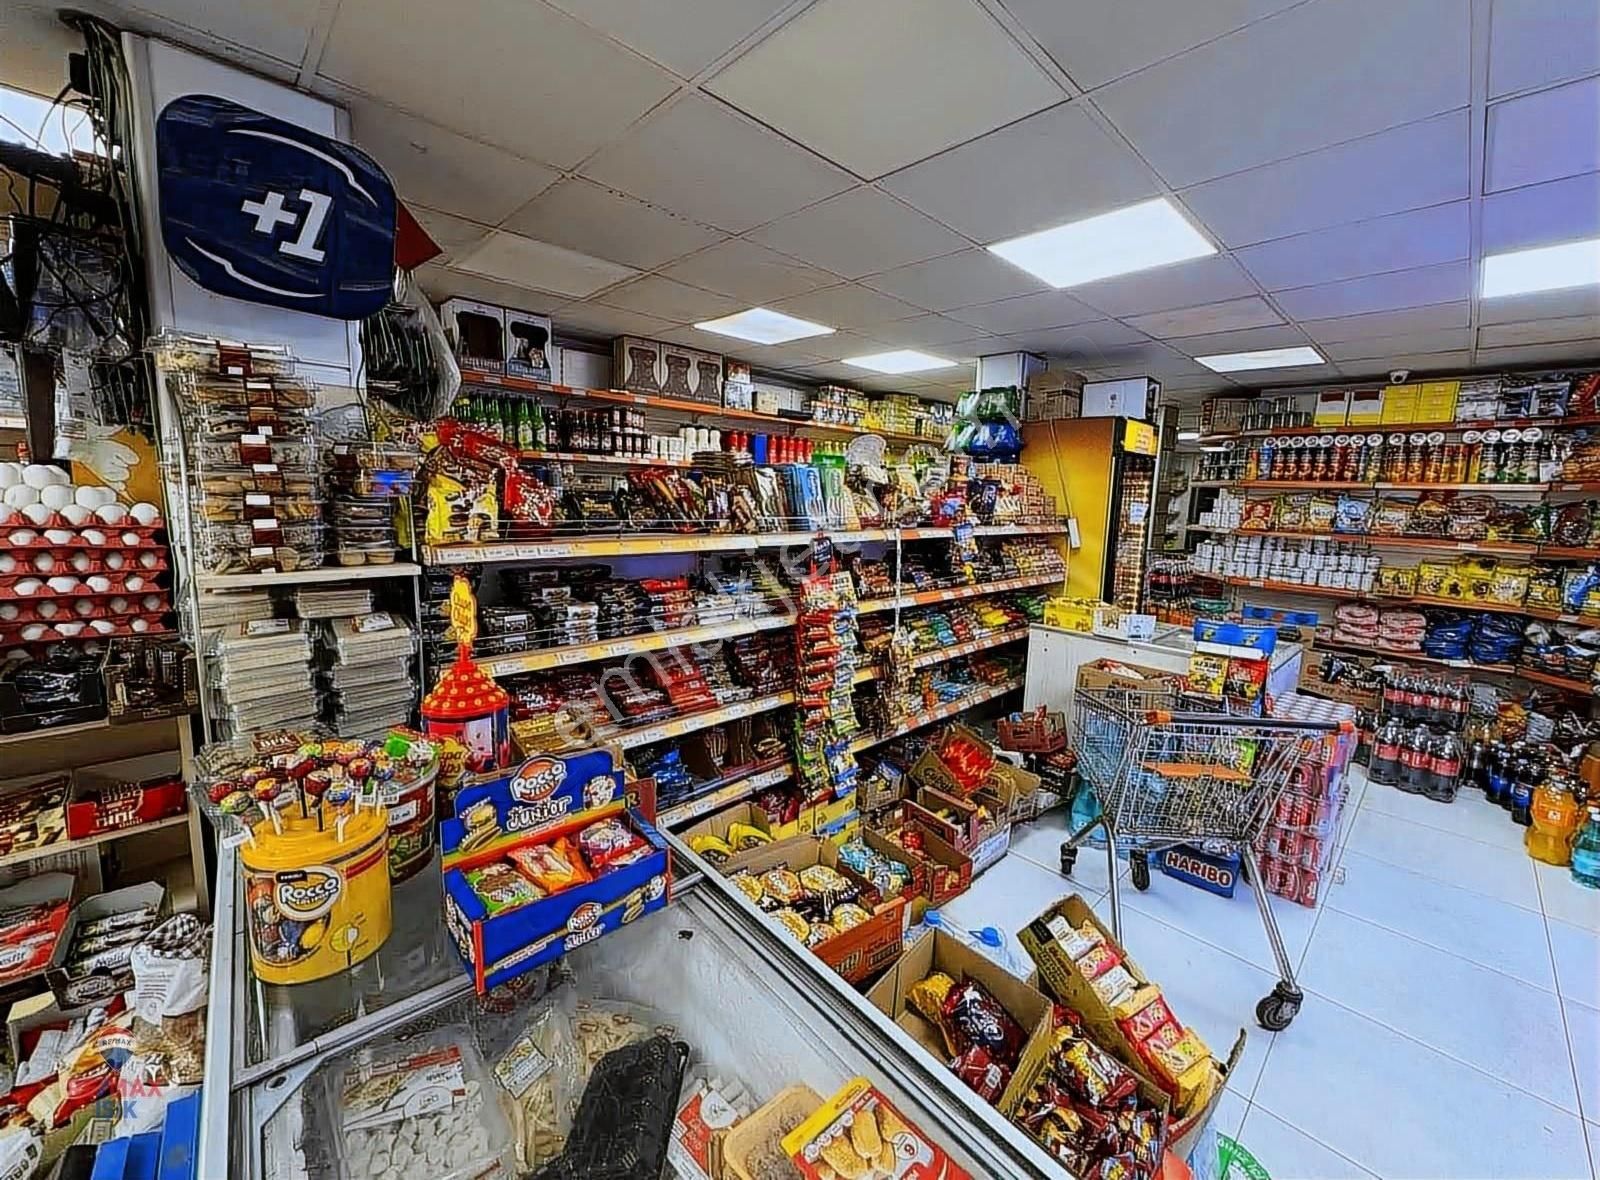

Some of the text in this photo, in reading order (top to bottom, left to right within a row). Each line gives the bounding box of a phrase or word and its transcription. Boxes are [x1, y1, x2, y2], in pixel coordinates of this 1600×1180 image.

[241, 188, 332, 262] +1
[511, 763, 566, 798] Rocco
[1166, 851, 1233, 888] HARIBO
[280, 877, 339, 904] Rocco
